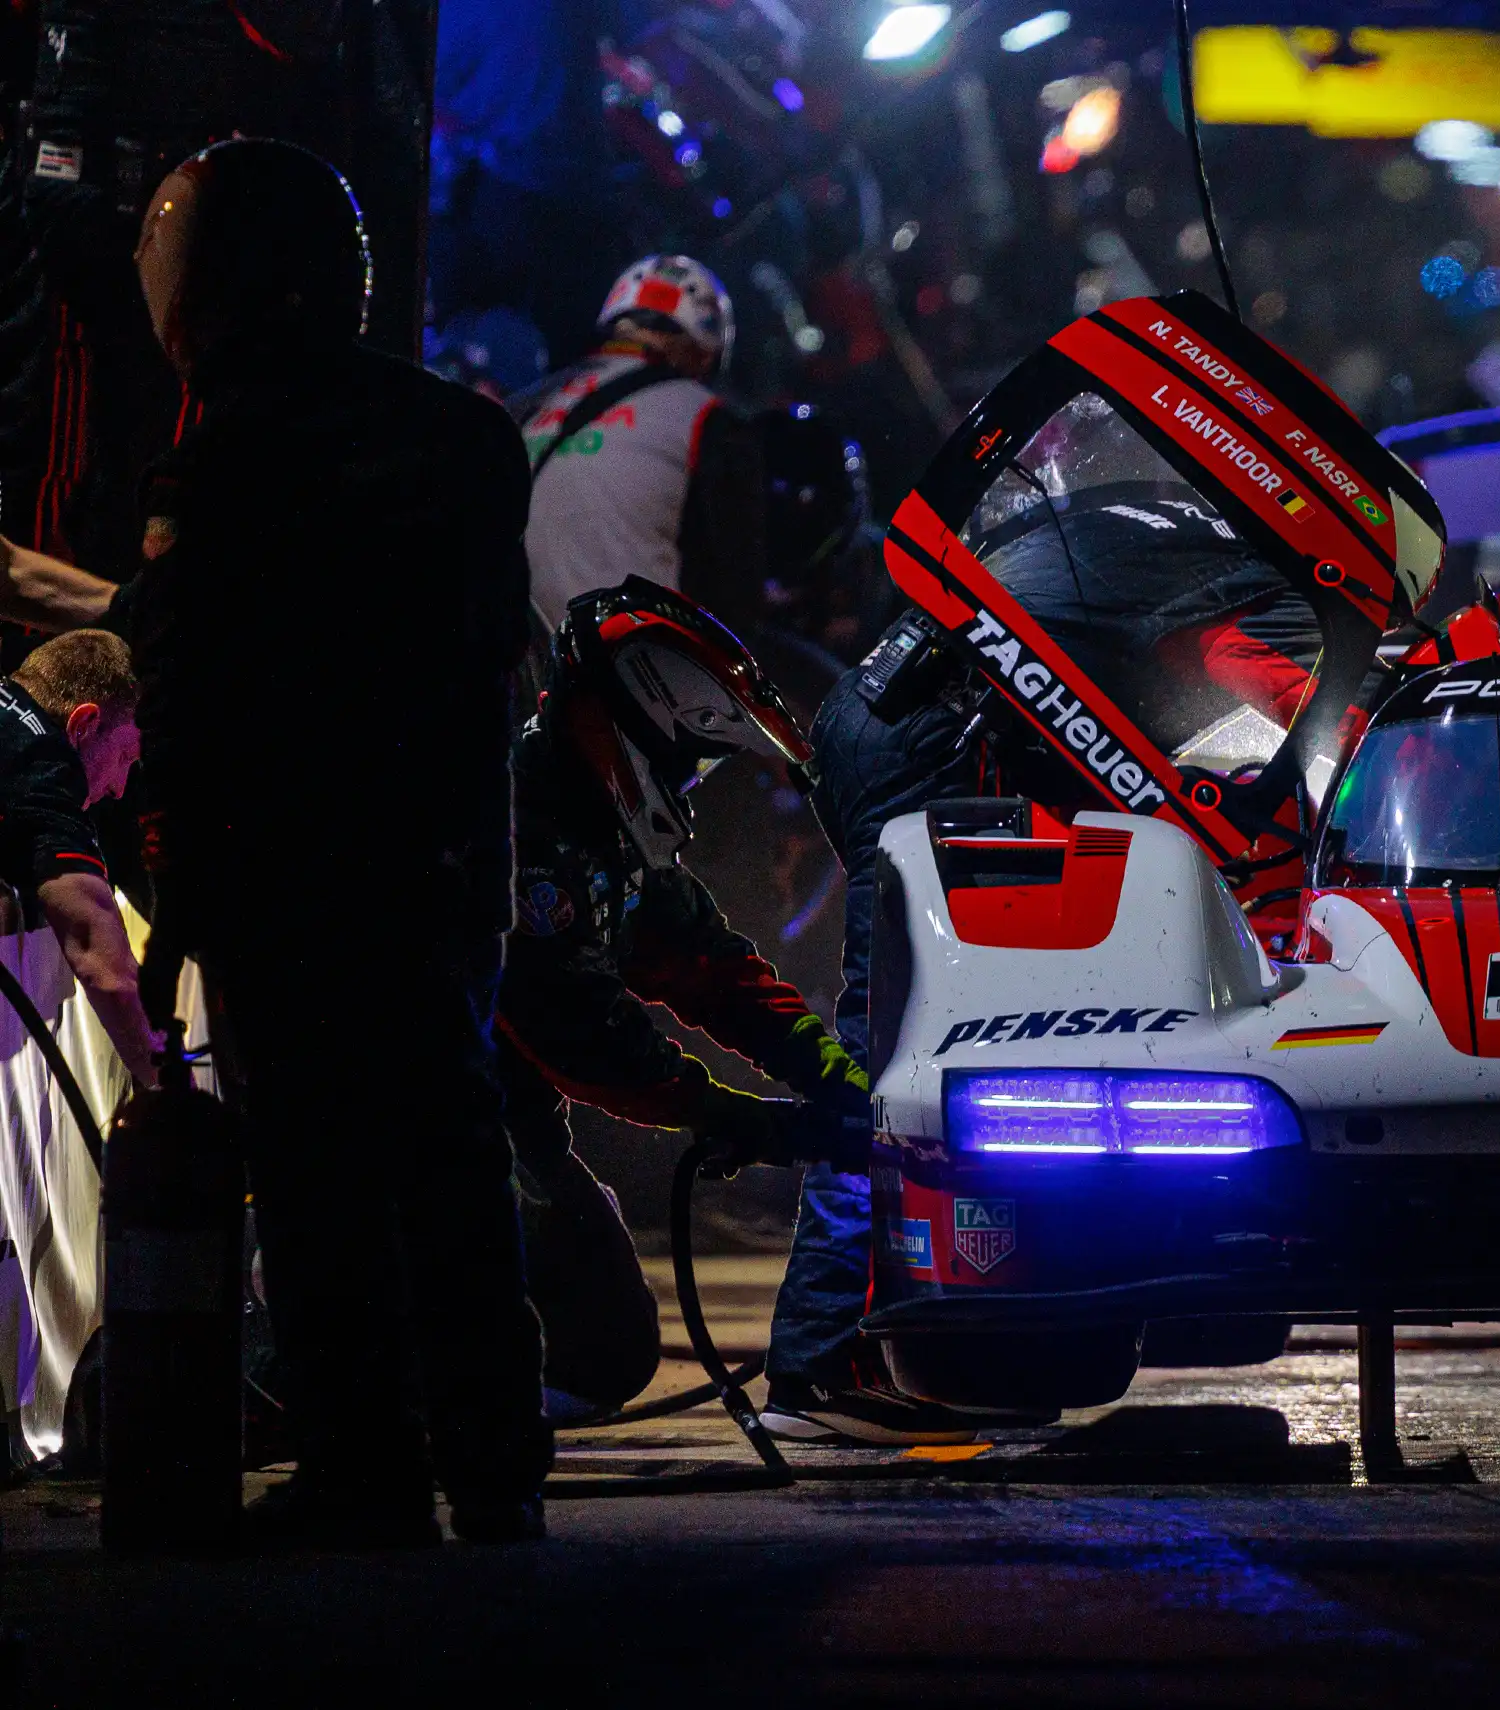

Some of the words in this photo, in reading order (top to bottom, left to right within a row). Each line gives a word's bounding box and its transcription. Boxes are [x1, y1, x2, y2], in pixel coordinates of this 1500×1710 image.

[1147, 319, 1170, 343] N.
[1168, 334, 1246, 390] TANDY
[1149, 384, 1171, 411] L.
[1168, 397, 1284, 495] VANTHOOR
[1283, 427, 1307, 452] F.
[1303, 443, 1361, 499] NASR
[932, 1007, 1201, 1057] PENSKE
[958, 1202, 1011, 1226] TAG
[957, 1230, 1013, 1265] HEUER
